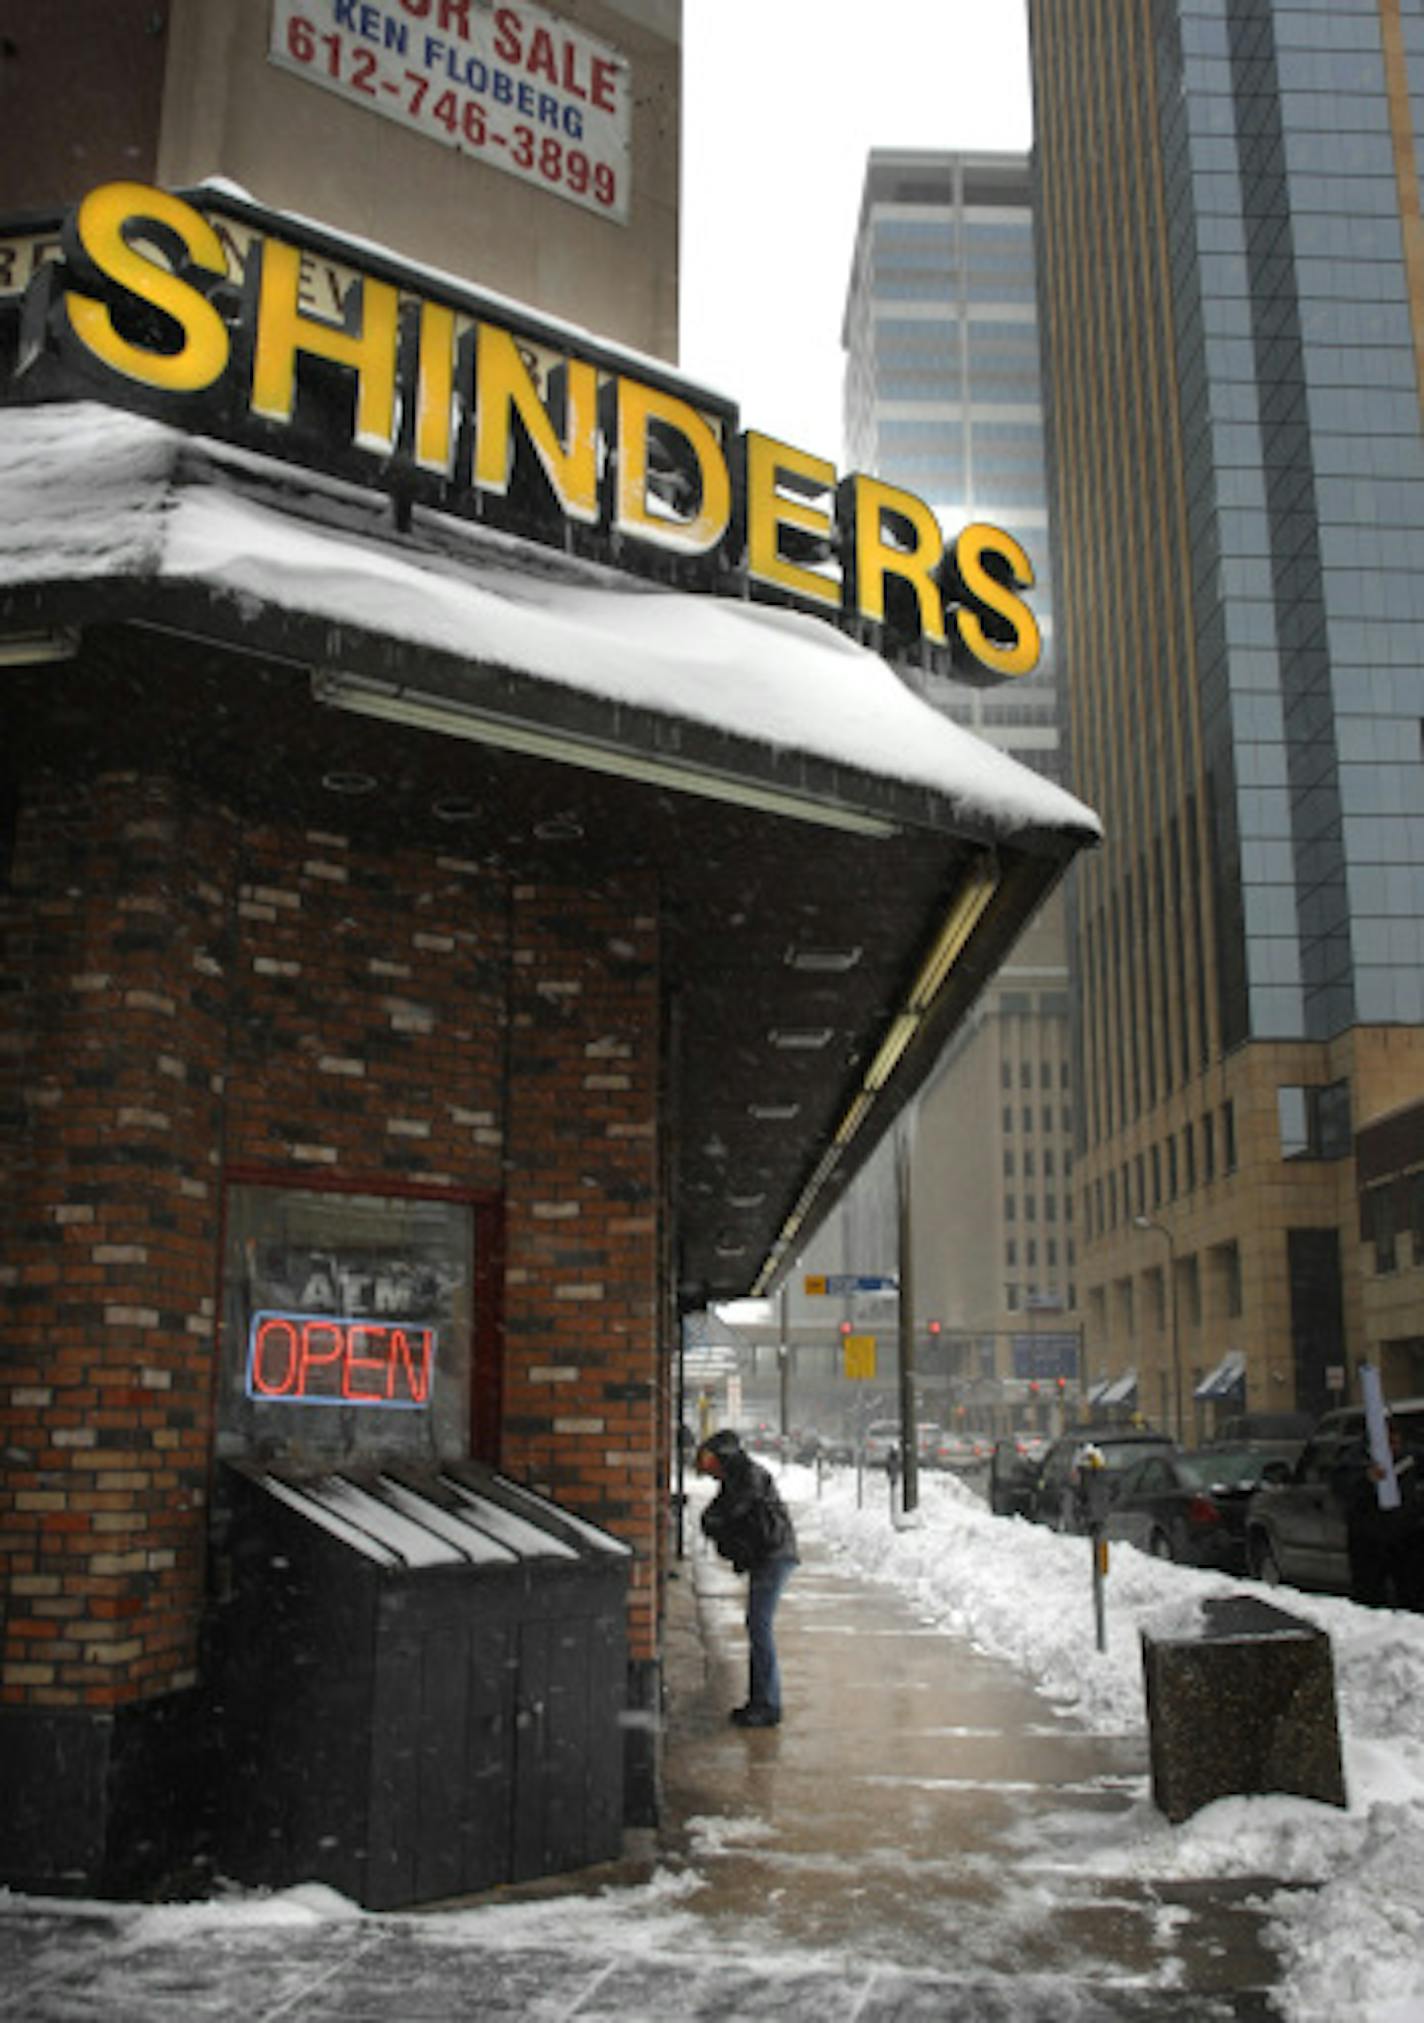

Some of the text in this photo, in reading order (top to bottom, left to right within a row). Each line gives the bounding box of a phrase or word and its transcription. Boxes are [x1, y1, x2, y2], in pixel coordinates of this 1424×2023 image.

[286, 16, 616, 207] 612-746-3899
[334, 0, 584, 140] KEN FLOBERG
[493, 8, 616, 115] SALE
[64, 181, 1042, 677] SHINDERS
[253, 1319, 433, 1403] OPEN
